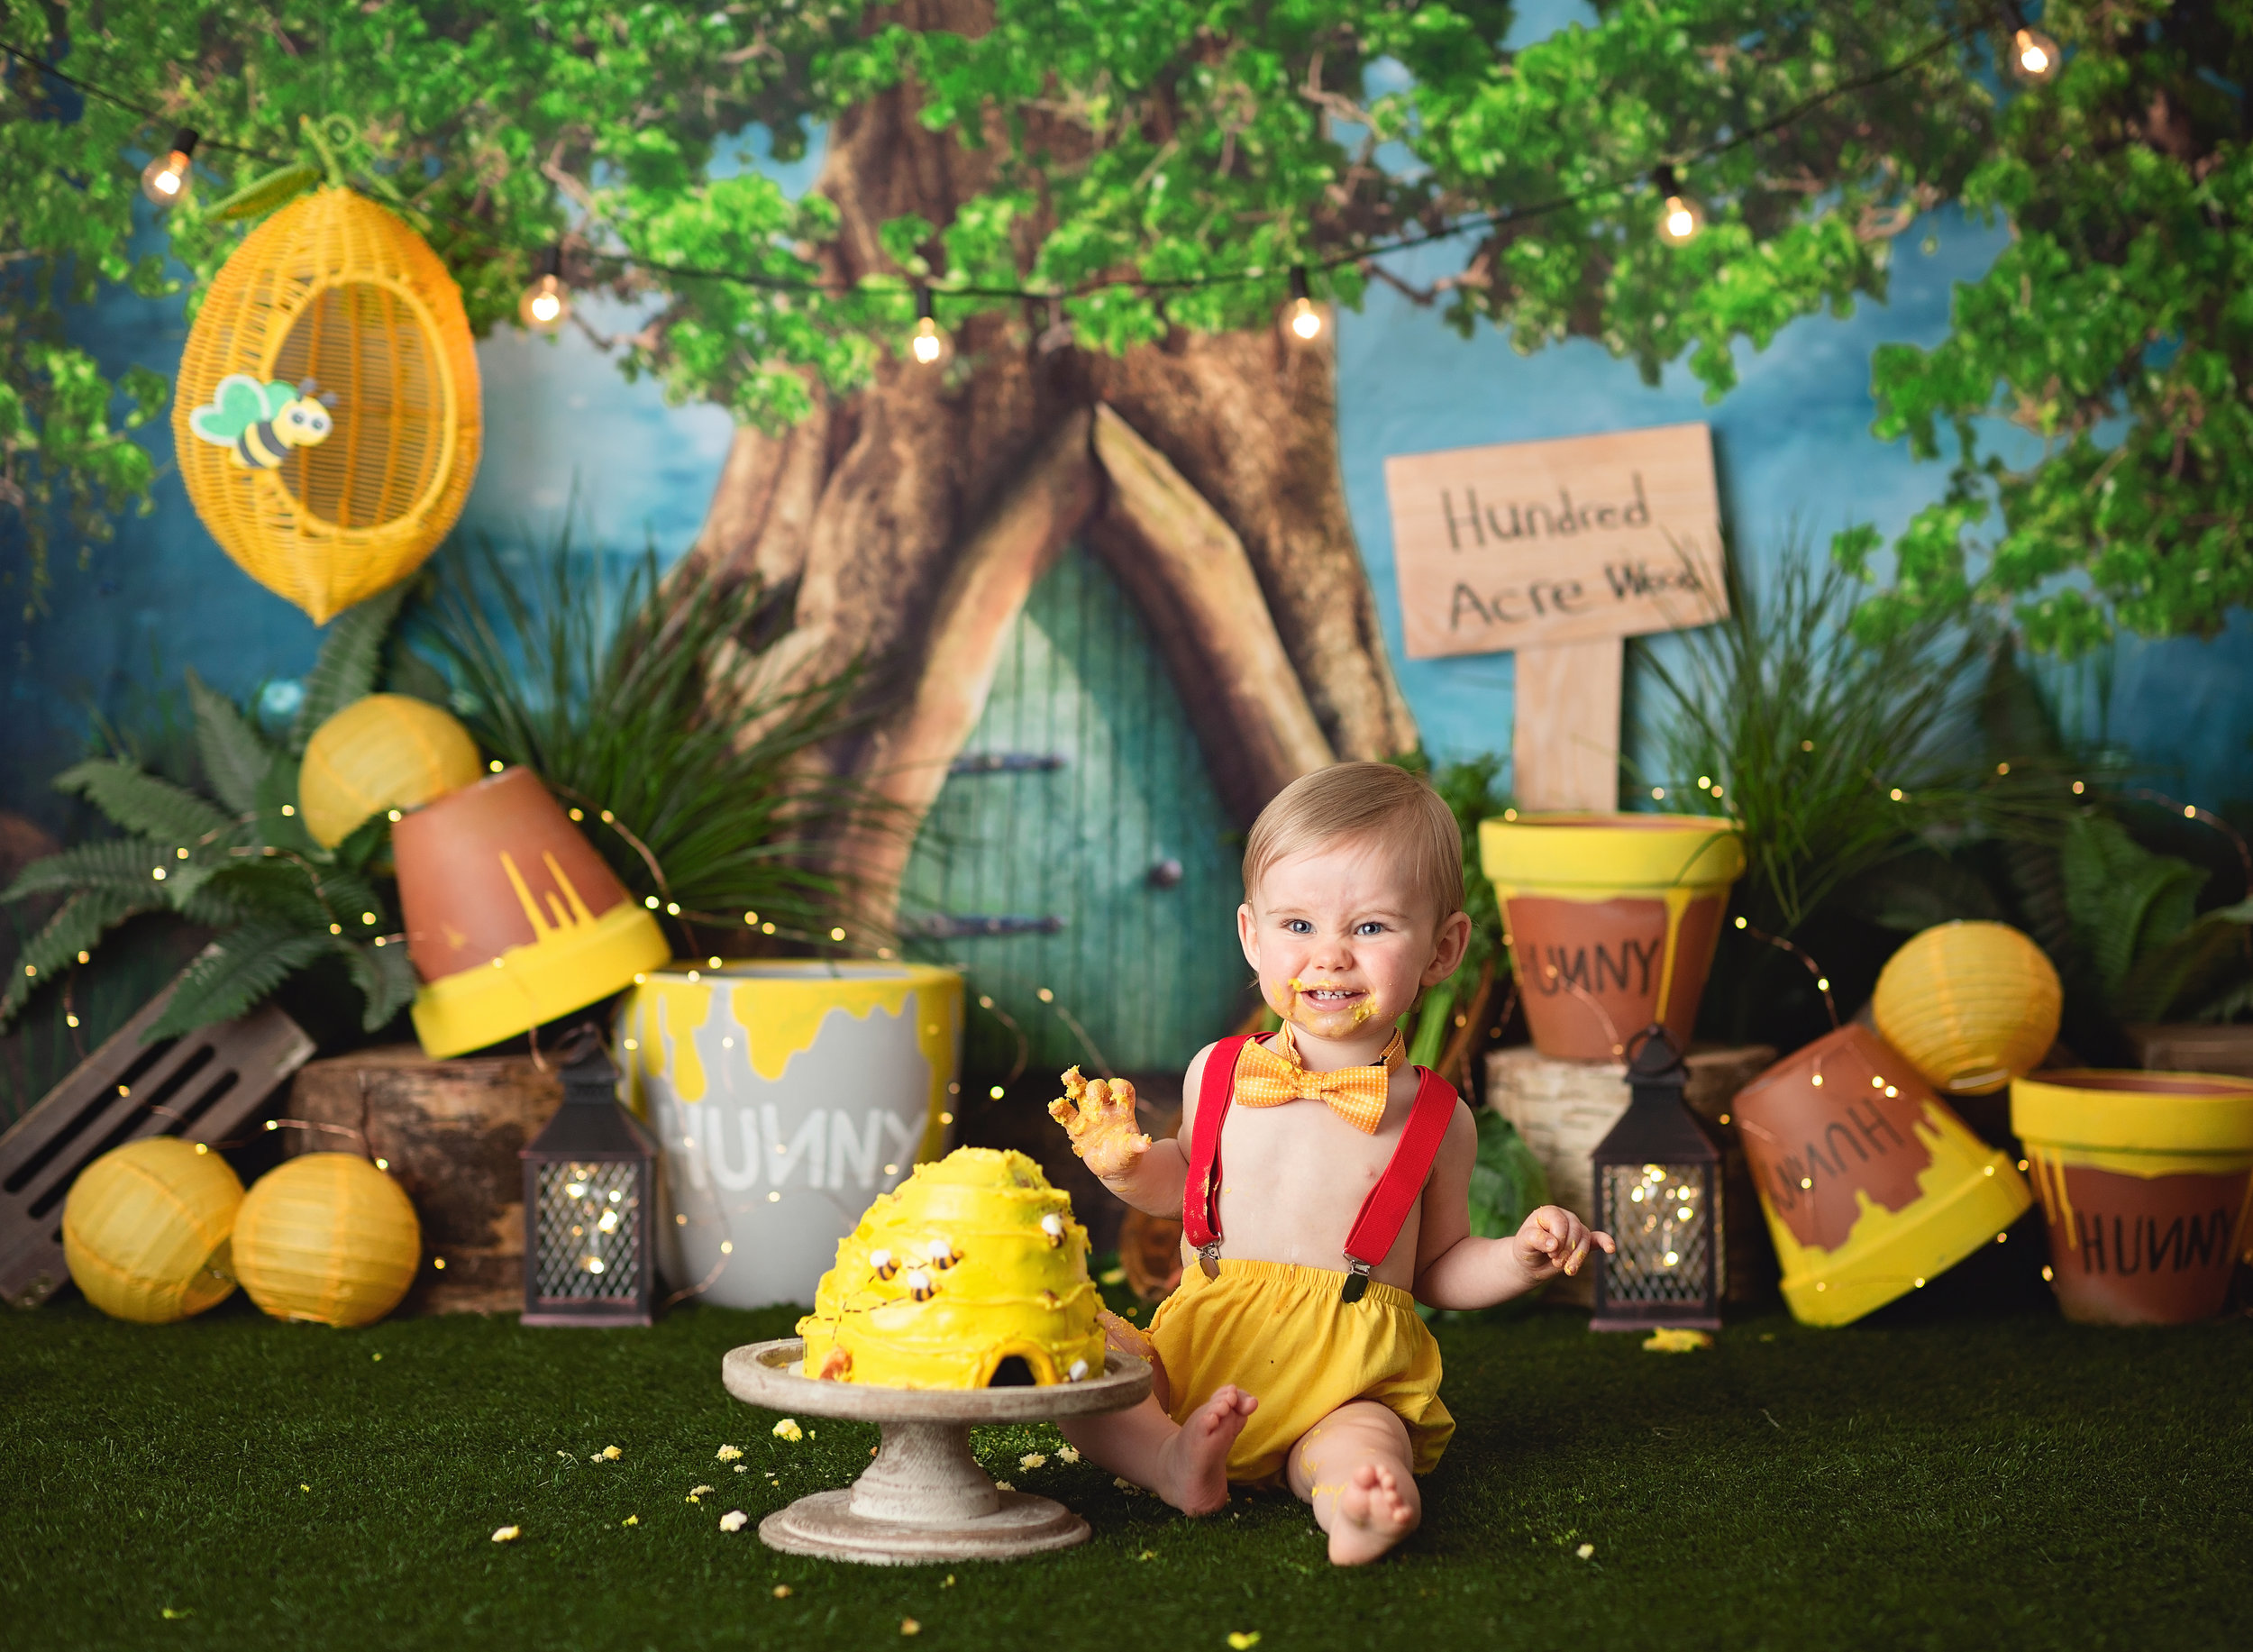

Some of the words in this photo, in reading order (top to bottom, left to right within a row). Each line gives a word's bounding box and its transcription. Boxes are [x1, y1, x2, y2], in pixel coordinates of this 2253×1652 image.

[1442, 470, 1651, 552] Hundred
[1447, 577, 1593, 631] Acre
[1604, 559, 1704, 601] Wood
